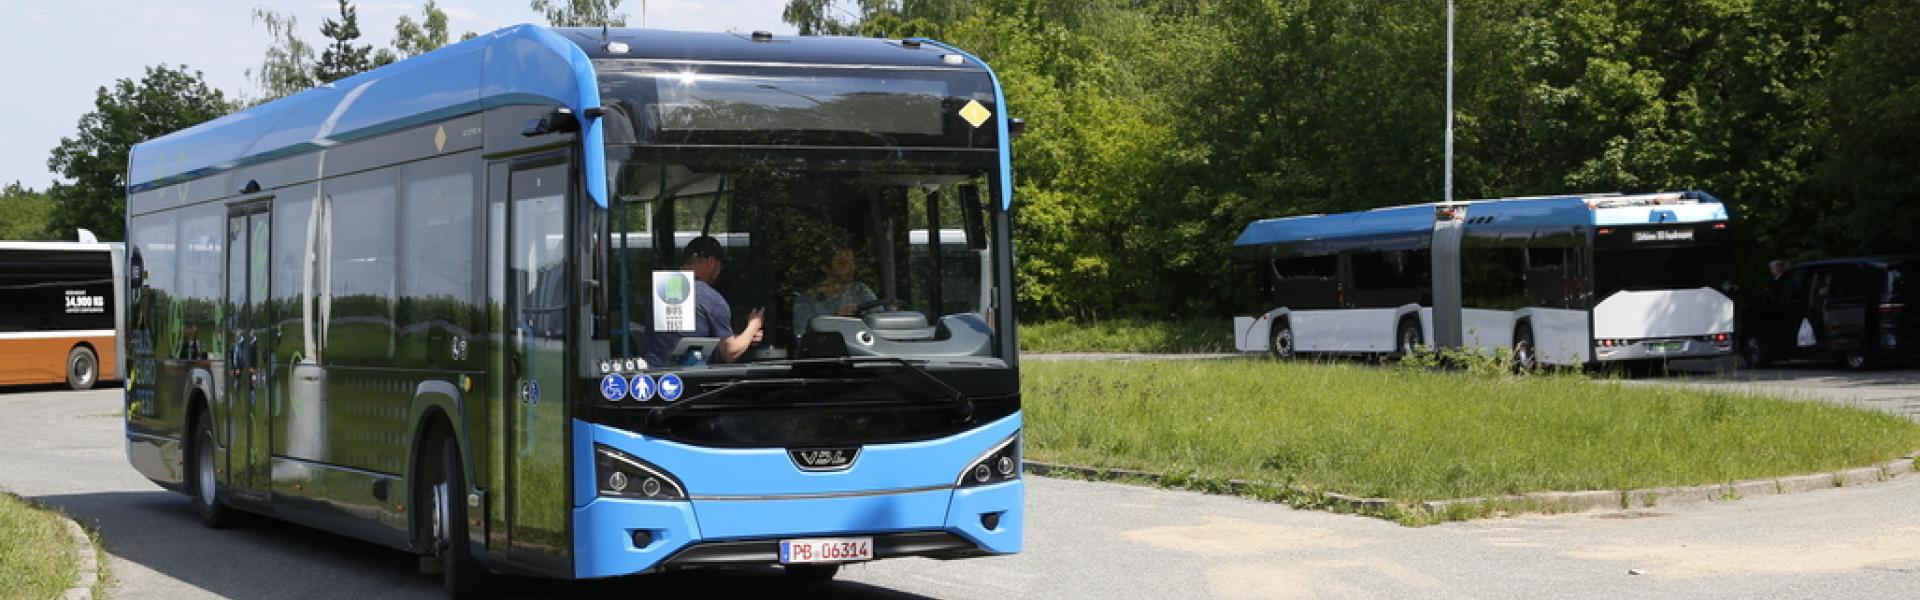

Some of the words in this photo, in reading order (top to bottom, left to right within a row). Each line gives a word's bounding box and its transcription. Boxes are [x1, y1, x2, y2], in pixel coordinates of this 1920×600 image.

[801, 450, 847, 465] VDL
[793, 544, 812, 560] PB
[822, 541, 868, 560] 06314
